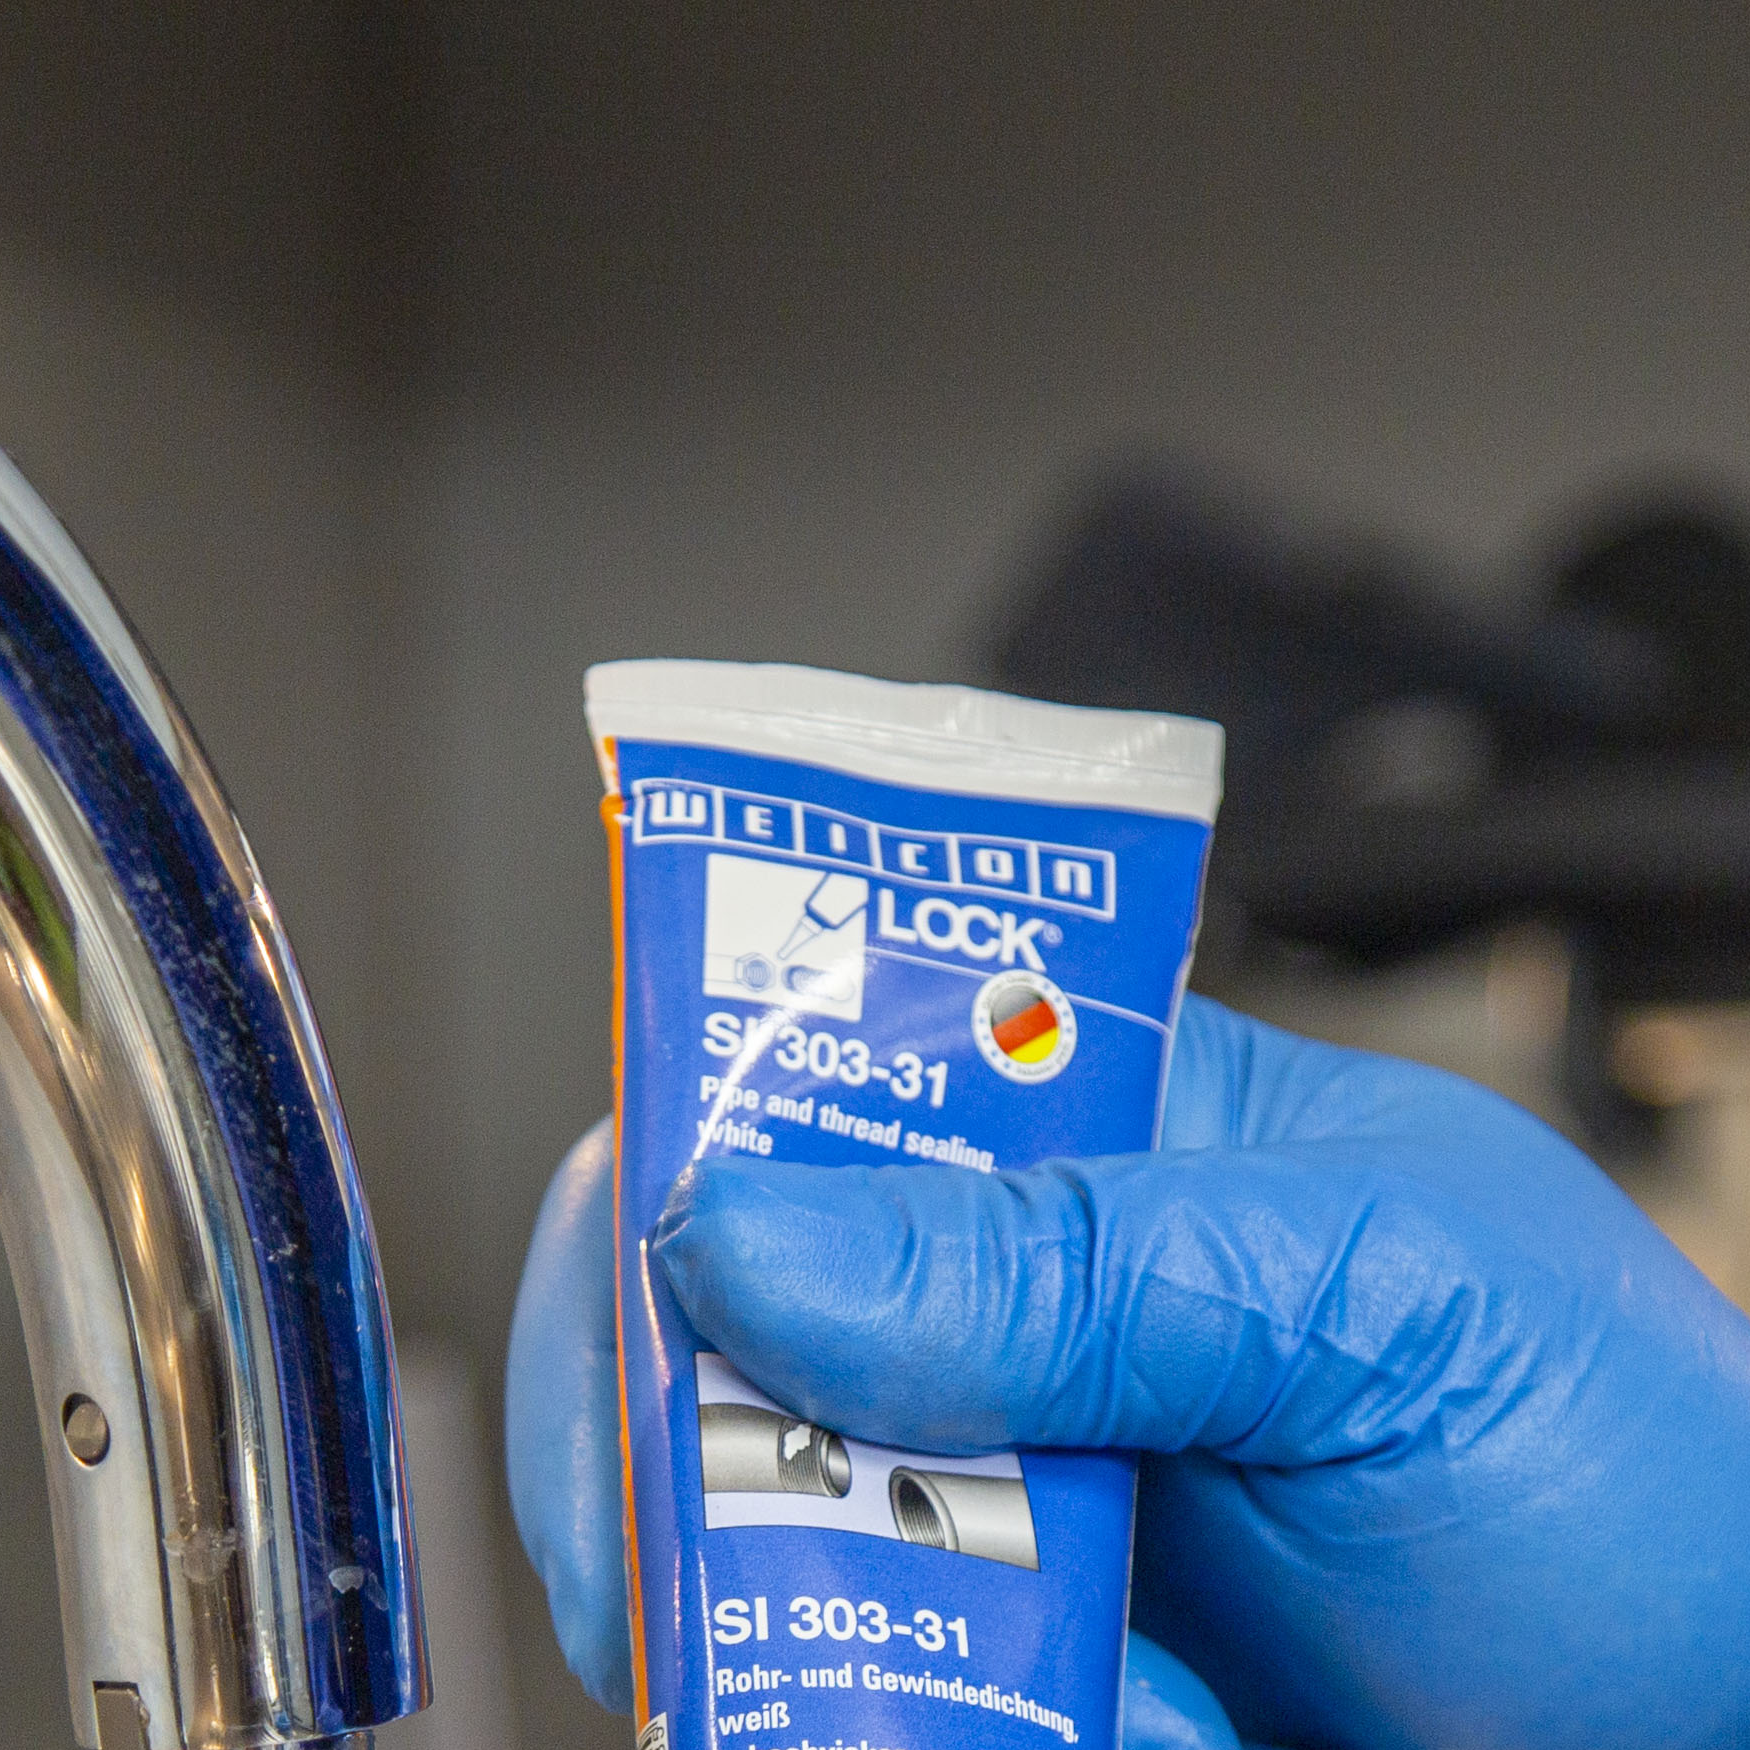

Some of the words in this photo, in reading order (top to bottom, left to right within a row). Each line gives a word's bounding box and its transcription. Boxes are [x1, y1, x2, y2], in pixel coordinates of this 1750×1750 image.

[774, 1024, 949, 1108] 303-31
[697, 1117, 774, 1156] white
[765, 1093, 814, 1125] and
[818, 1102, 902, 1149] thread
[713, 1596, 769, 1645] SI
[788, 1596, 969, 1658] 303-31
[715, 1664, 793, 1696] Rohr-
[801, 1662, 853, 1689] und
[862, 1663, 1080, 1744] Gewindedichtung,
[718, 1701, 791, 1736] weiß
